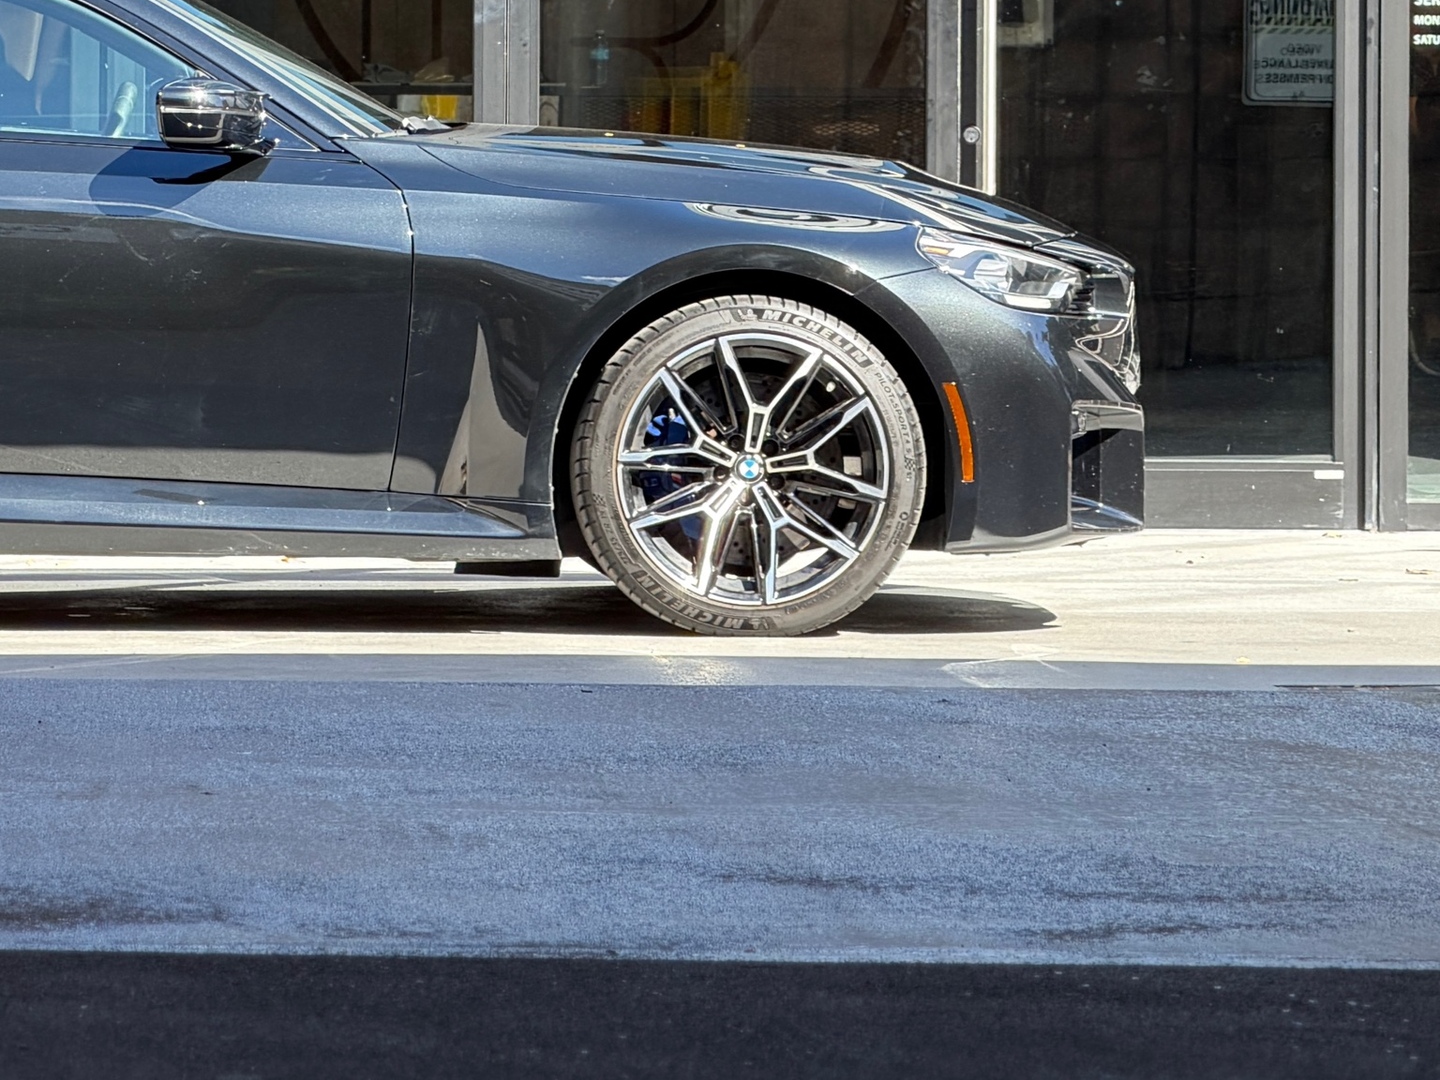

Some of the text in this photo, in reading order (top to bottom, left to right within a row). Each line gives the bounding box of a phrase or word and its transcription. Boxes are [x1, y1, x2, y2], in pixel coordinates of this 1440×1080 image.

[762, 309, 869, 365] MICHELIN
[874, 372, 896, 400] PILOT
[892, 401, 910, 438] SPORT
[636, 569, 745, 629] MICHELIN
